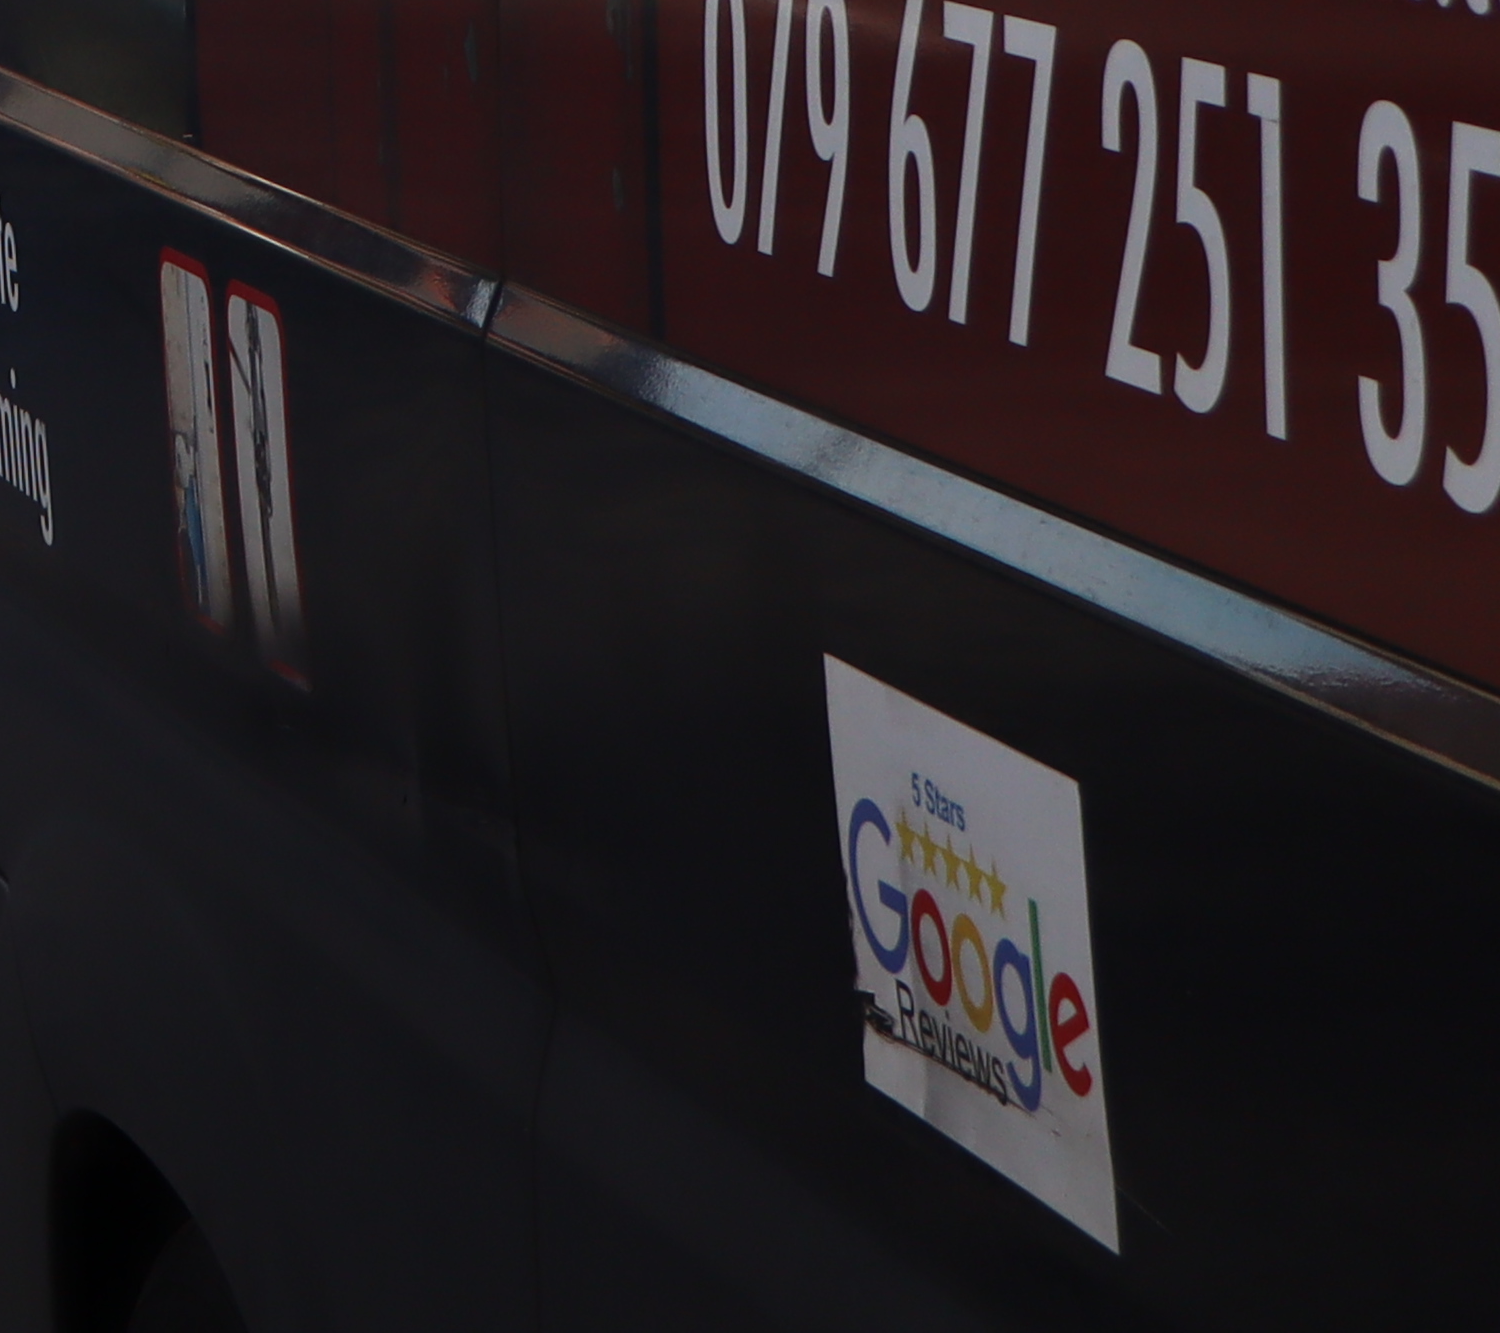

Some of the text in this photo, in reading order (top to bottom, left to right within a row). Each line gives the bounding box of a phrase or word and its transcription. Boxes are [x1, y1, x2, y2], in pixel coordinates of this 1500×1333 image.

[1101, 38, 1289, 441] 251
[1356, 99, 1500, 515] 35
[910, 771, 967, 833] 5 Stars
[848, 797, 1093, 1113] Google
[894, 978, 1010, 1108] Reviews
